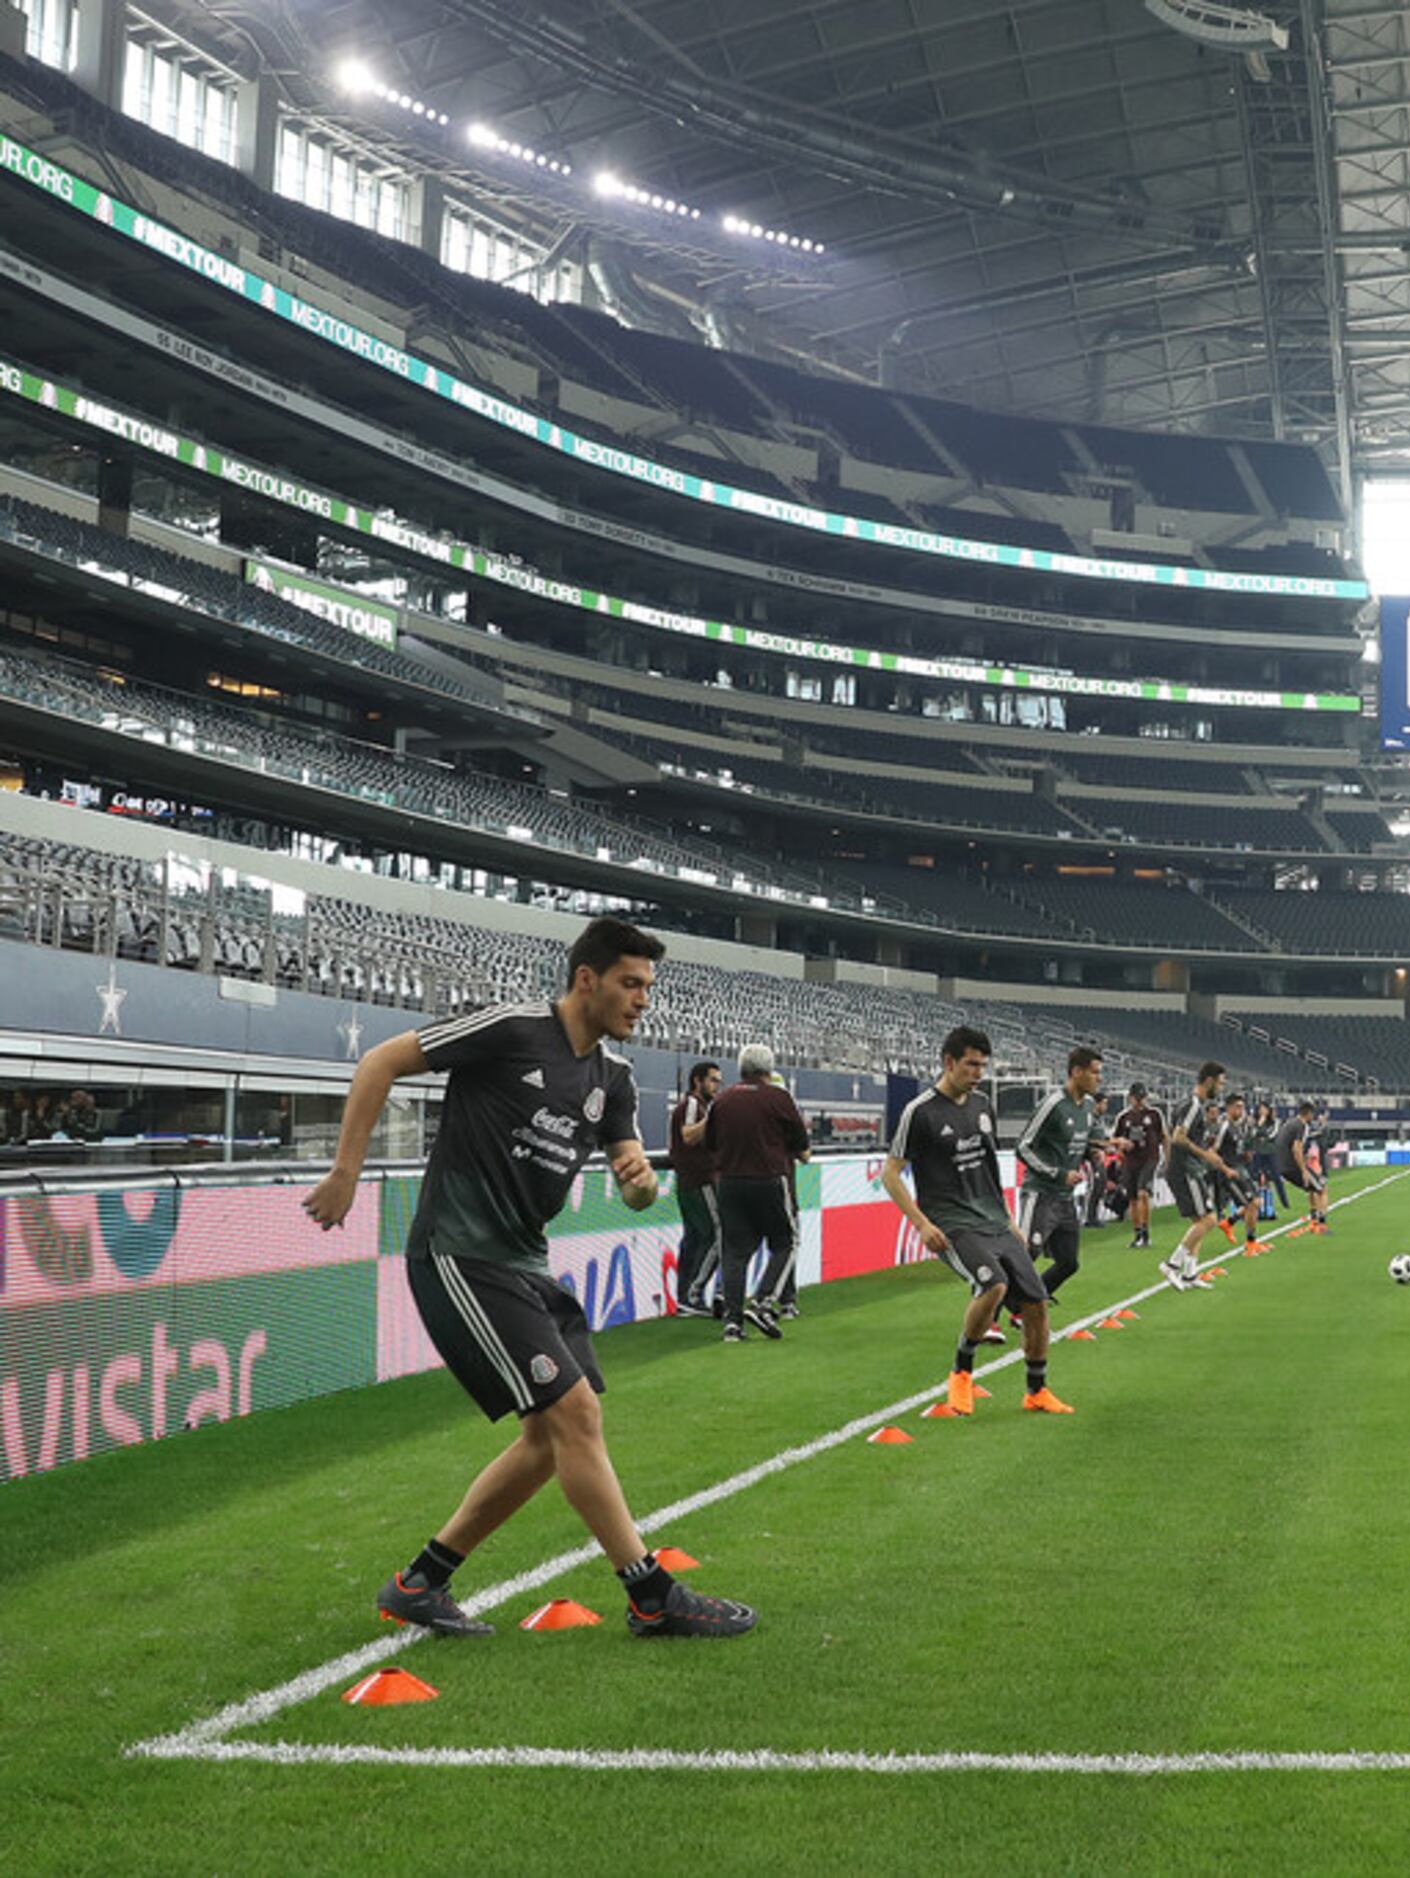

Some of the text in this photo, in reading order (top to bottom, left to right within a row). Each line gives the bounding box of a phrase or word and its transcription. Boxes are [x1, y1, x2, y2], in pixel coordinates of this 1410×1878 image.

[132, 215, 245, 296] #MEXTOUR
[291, 298, 409, 376] MEXTOUR.ORG
[574, 437, 685, 491] MEXTOUR.ORG
[74, 396, 178, 459] #MEXTOUR
[221, 457, 331, 518] MEXTOUR.ORG
[1028, 673, 1142, 698] MEXTOUR.ORG
